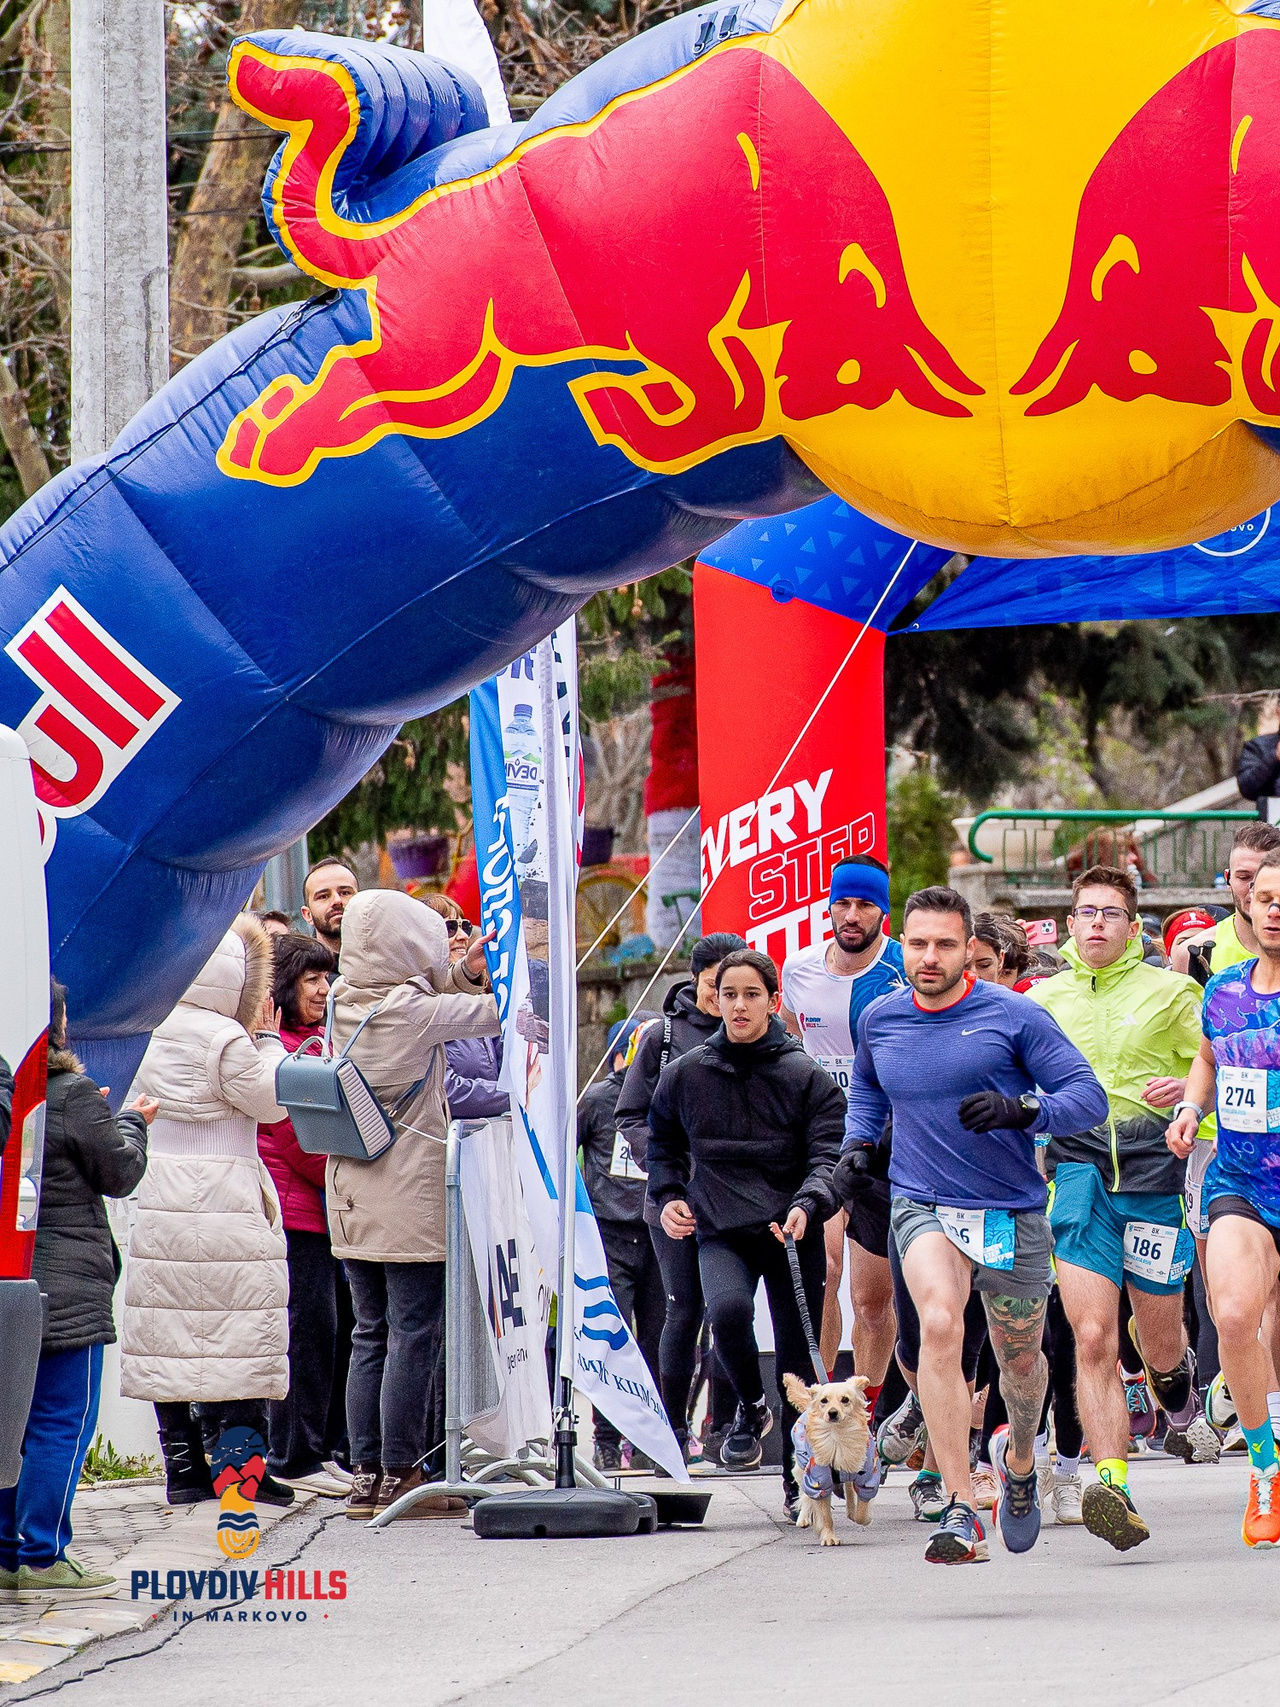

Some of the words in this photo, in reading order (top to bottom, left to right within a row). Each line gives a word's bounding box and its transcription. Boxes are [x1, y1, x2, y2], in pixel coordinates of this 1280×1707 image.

[15, 598, 168, 815] ull
[1225, 1086, 1256, 1108] 274
[1132, 1235, 1162, 1260] 186
